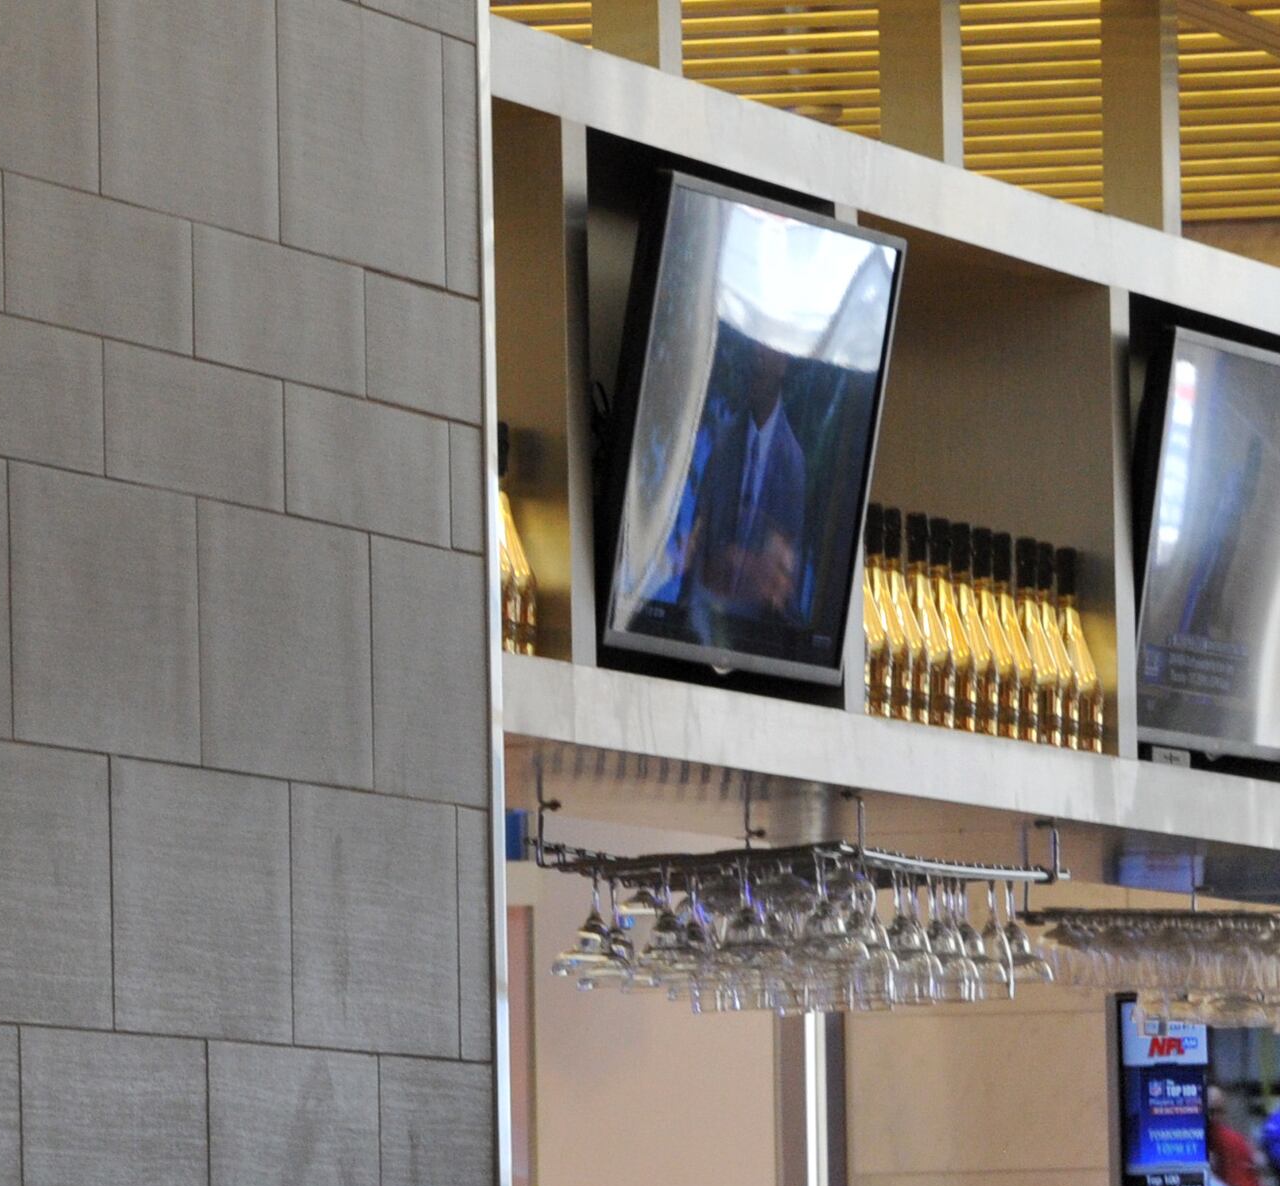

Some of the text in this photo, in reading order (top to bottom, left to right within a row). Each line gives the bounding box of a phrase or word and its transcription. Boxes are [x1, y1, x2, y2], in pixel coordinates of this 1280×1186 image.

[1148, 1035, 1185, 1057] NFL
[1145, 1174, 1180, 1186] Top 100
